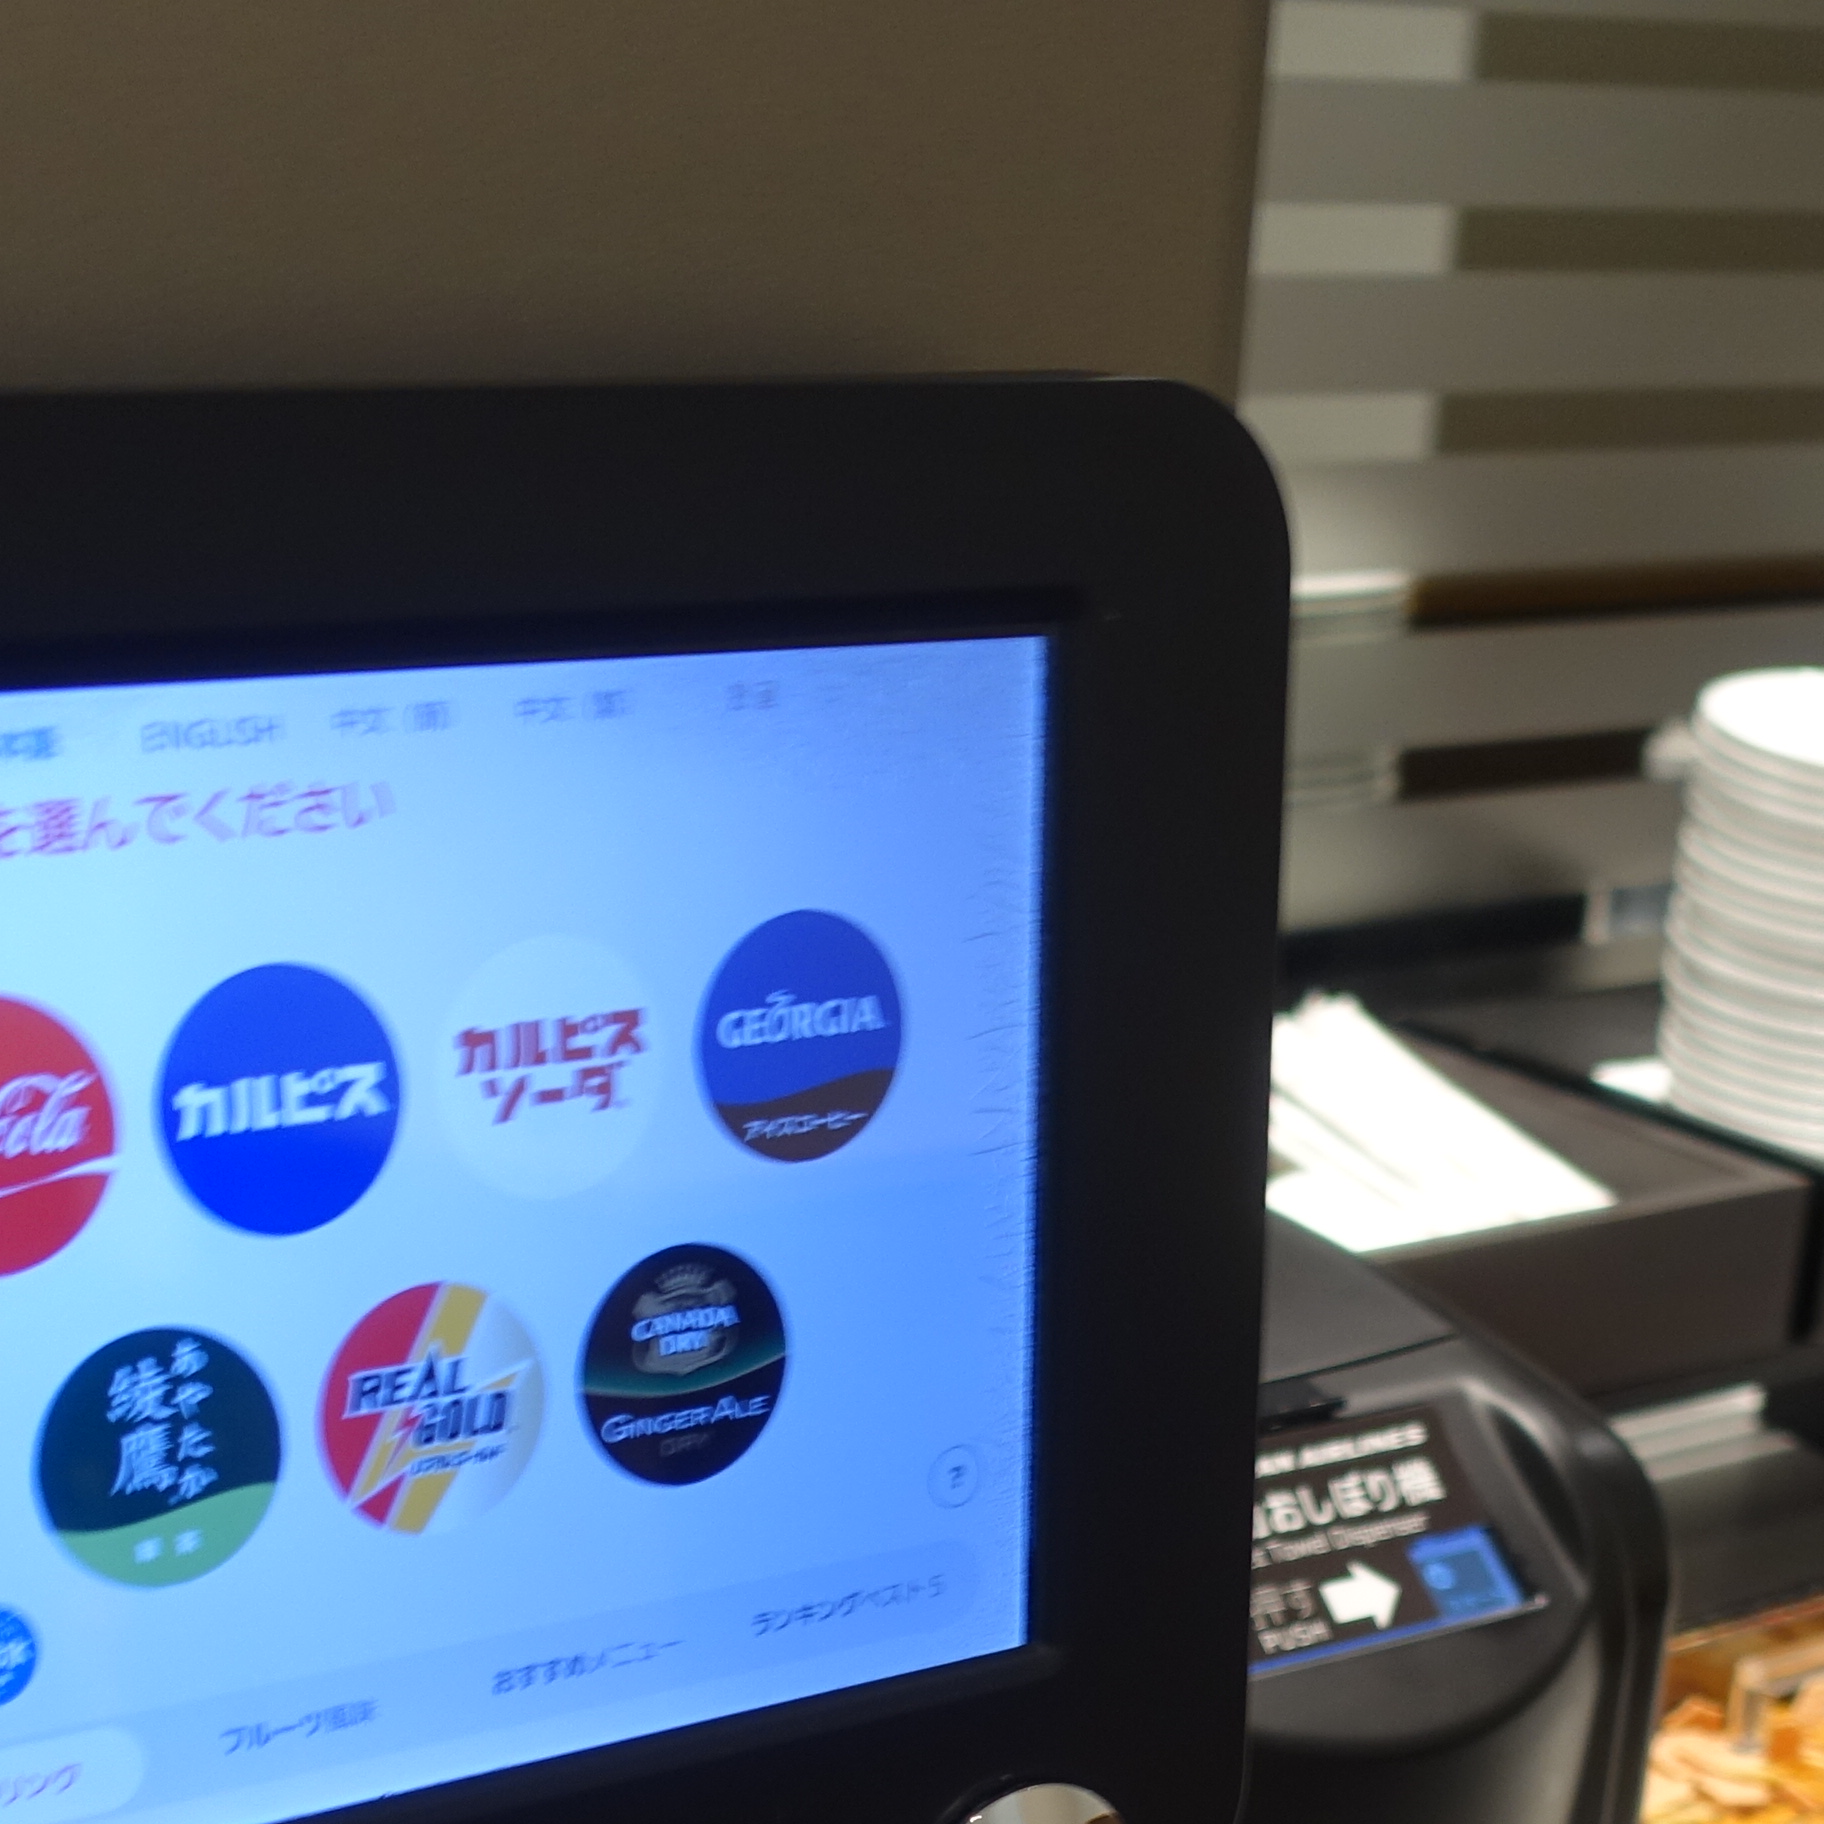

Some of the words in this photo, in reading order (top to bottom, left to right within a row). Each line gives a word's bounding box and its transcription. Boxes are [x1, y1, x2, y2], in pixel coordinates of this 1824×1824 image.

[452, 1006, 650, 1077] カルピス
[171, 1061, 389, 1142] カルピス
[479, 1061, 631, 1125] ソーダ
[631, 1305, 742, 1343] CANADA
[658, 1330, 711, 1356] DRY
[348, 1350, 472, 1414] REAL
[412, 1390, 509, 1447] GOLD
